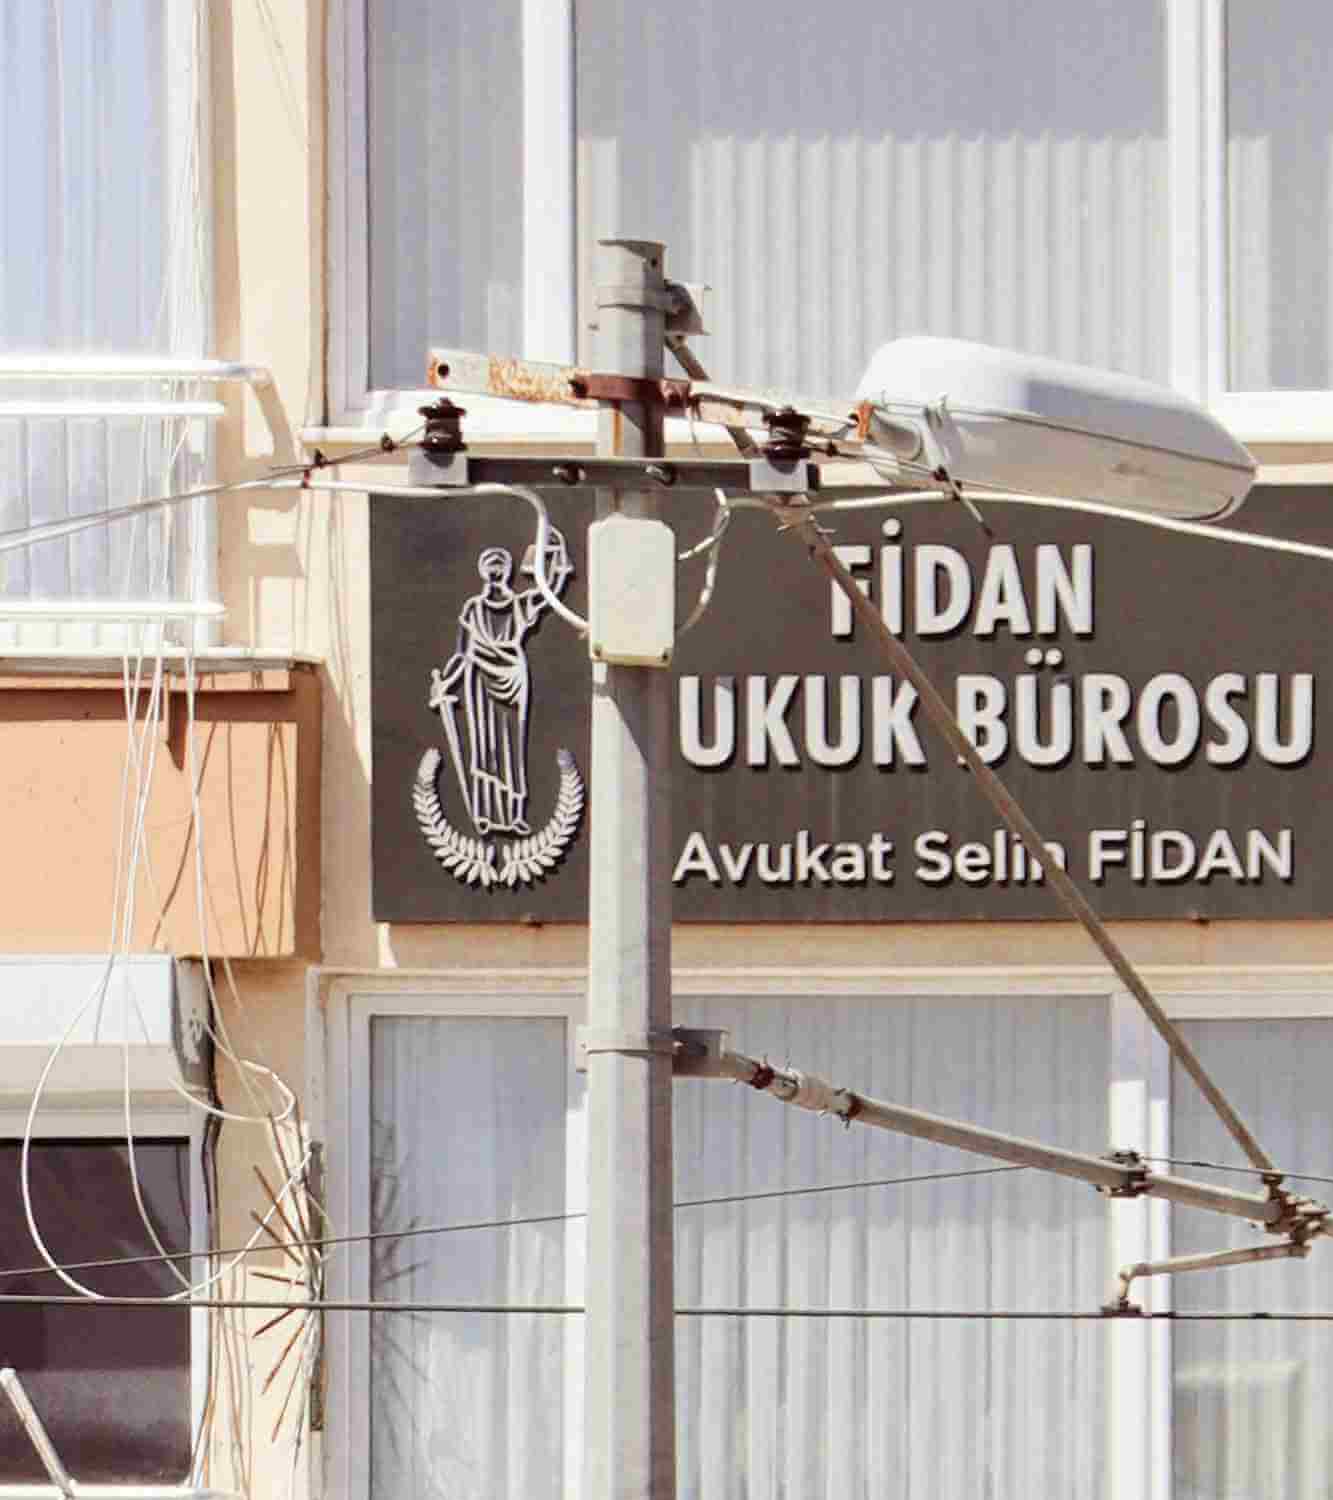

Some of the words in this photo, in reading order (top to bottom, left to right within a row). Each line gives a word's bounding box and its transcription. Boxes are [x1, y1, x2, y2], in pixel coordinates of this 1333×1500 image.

[831, 517, 1094, 637] FİDAN
[676, 673, 928, 768] UKUK
[956, 648, 1314, 768] BÜROSU
[672, 828, 894, 884] Avukat
[1087, 818, 1296, 883] FİDAN
